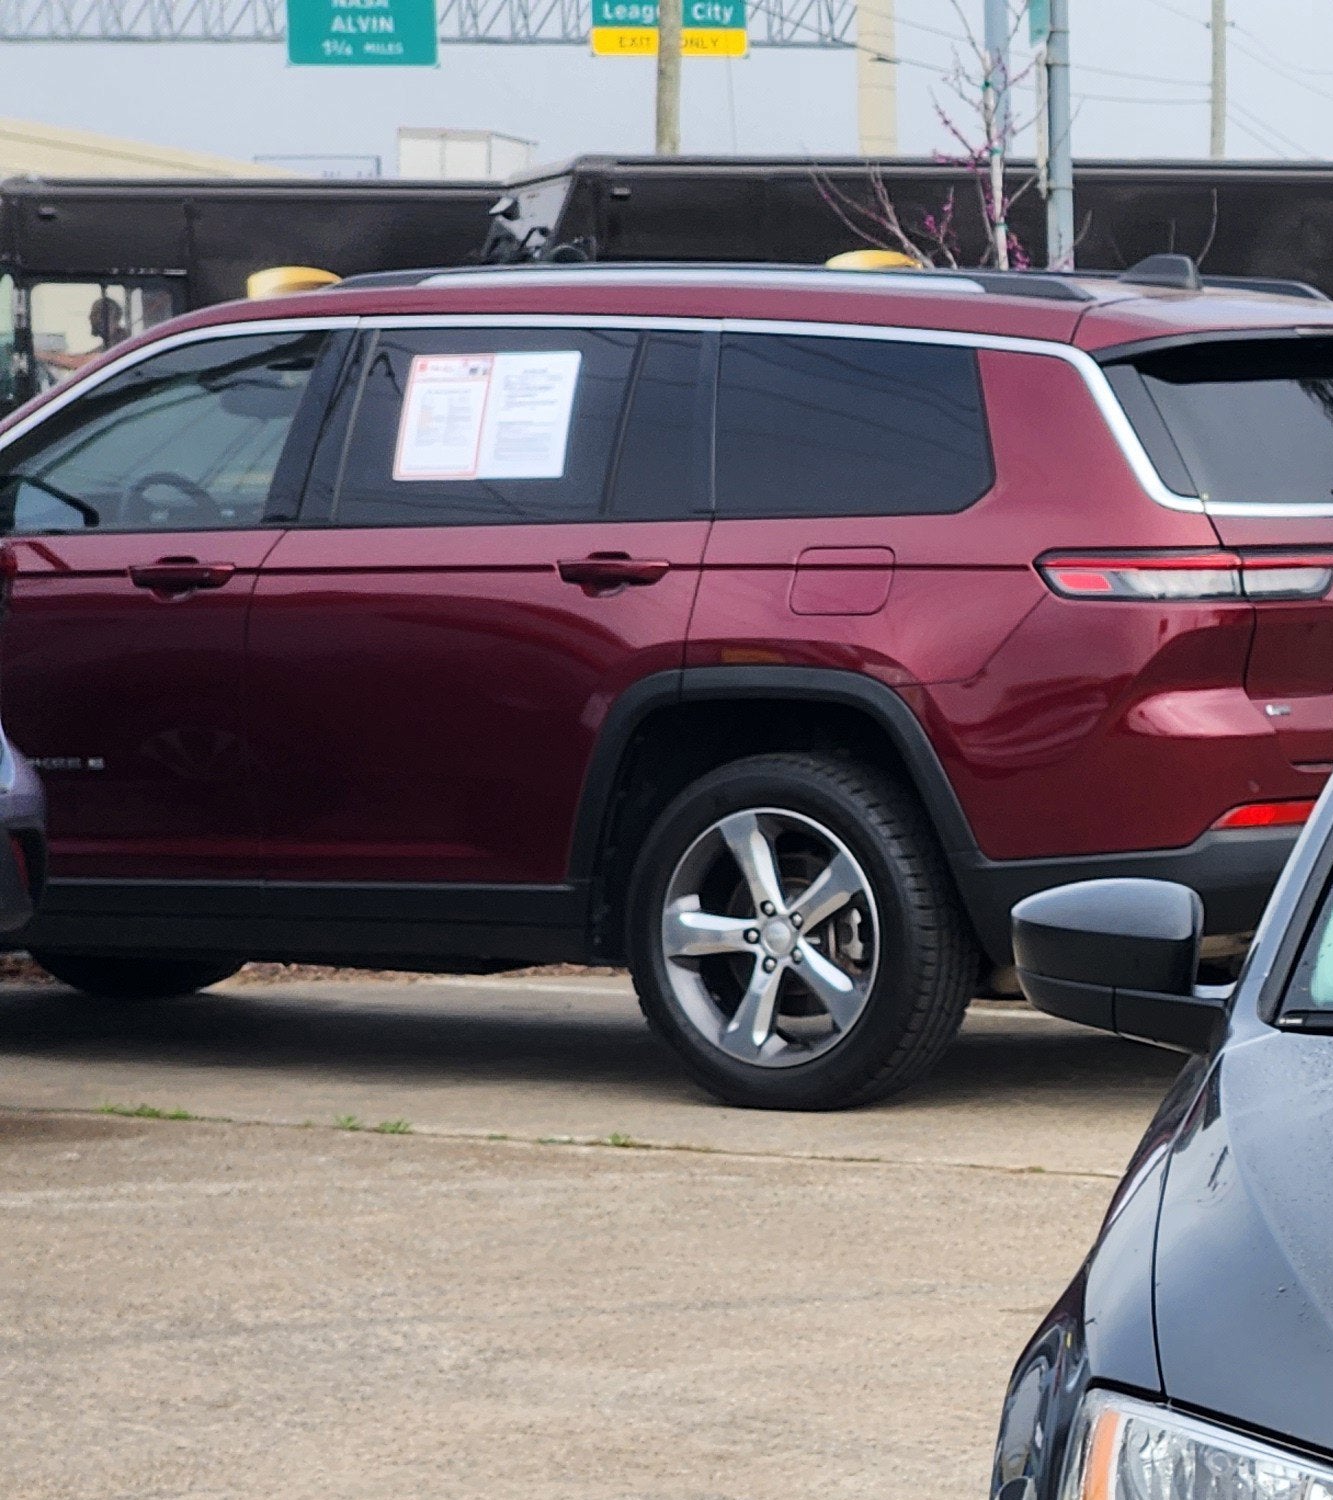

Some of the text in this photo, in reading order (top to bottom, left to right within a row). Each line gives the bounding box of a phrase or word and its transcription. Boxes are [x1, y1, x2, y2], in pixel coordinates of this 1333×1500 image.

[602, 1, 734, 24] Leag City
[330, 14, 395, 33] ALVIN
[618, 36, 651, 48] EXIT
